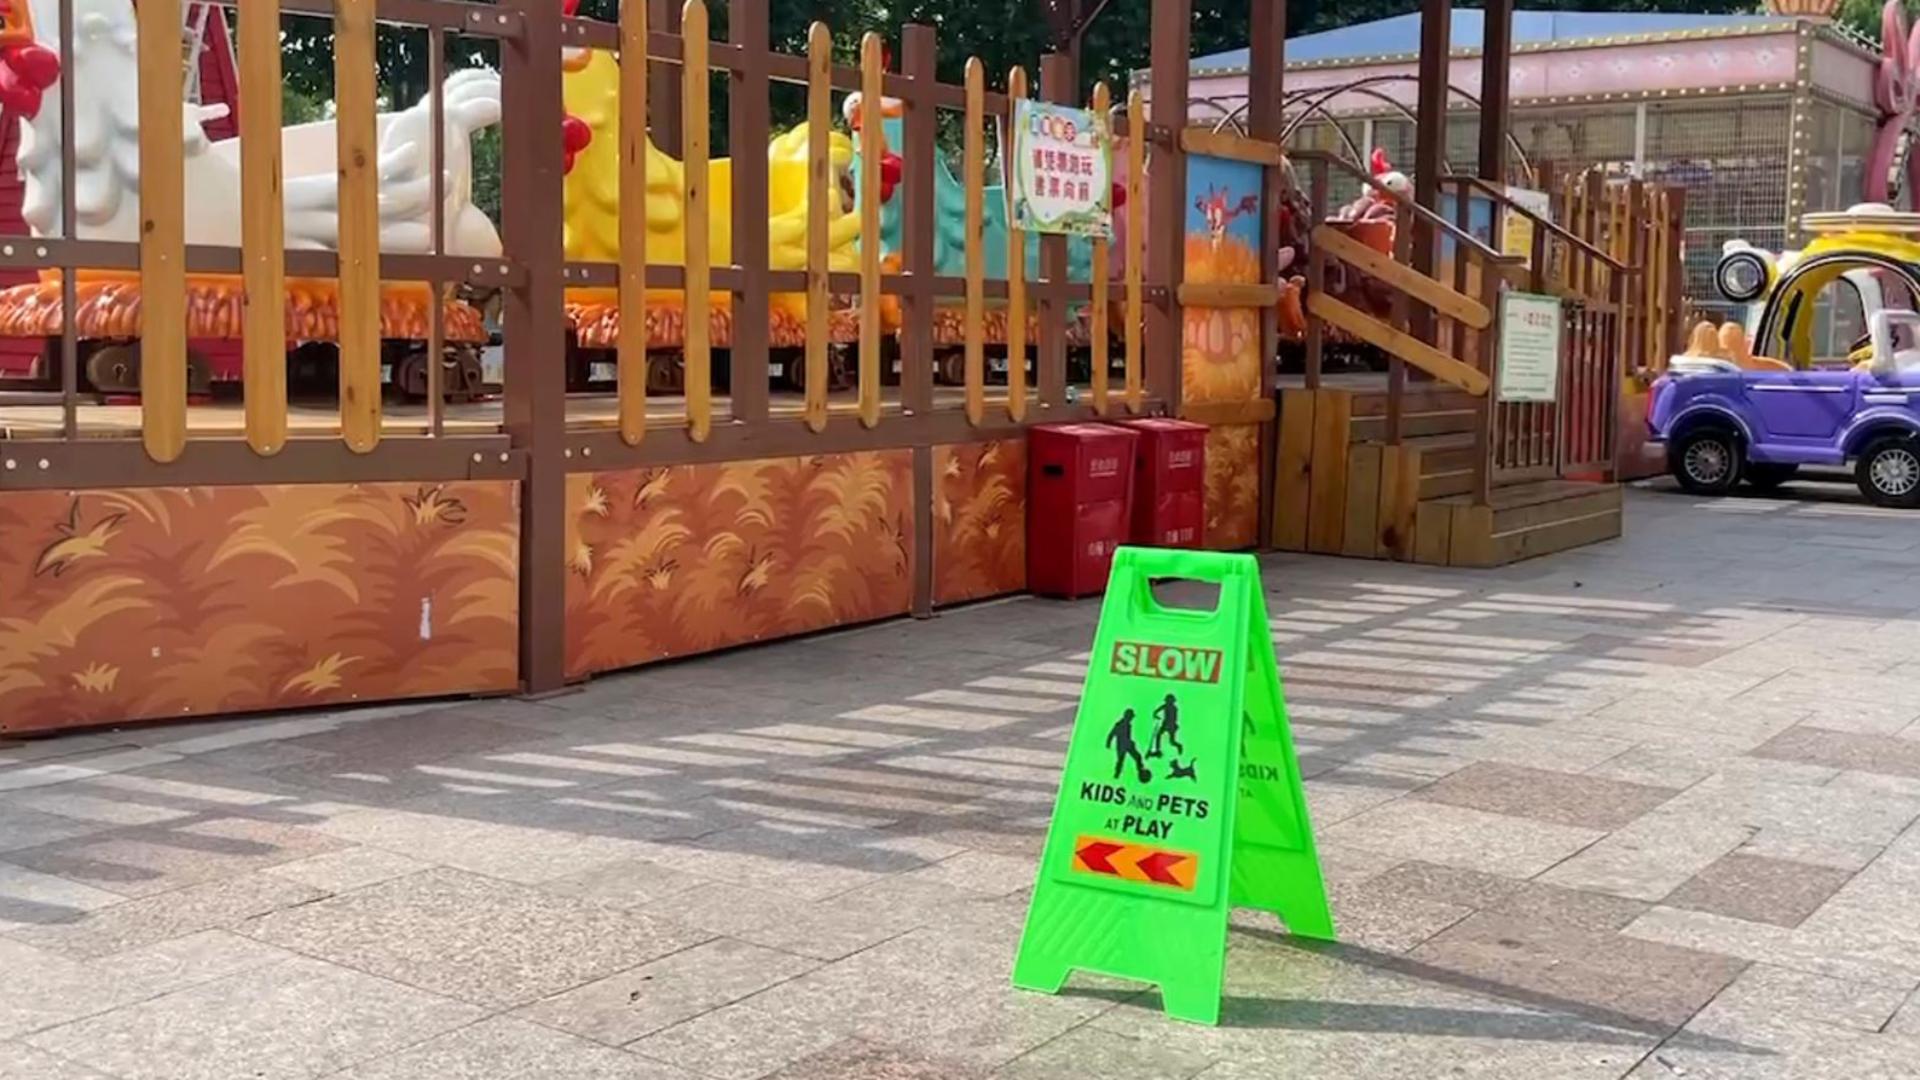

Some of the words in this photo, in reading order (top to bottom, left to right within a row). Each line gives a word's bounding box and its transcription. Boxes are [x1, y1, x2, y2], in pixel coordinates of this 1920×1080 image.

[1114, 643, 1219, 682] SLOW
[1080, 782, 1126, 806] KIDS
[1127, 795, 1153, 811] AND
[1156, 794, 1209, 819] PETS
[1104, 817, 1119, 831] AT
[1121, 815, 1173, 839] PLAY
